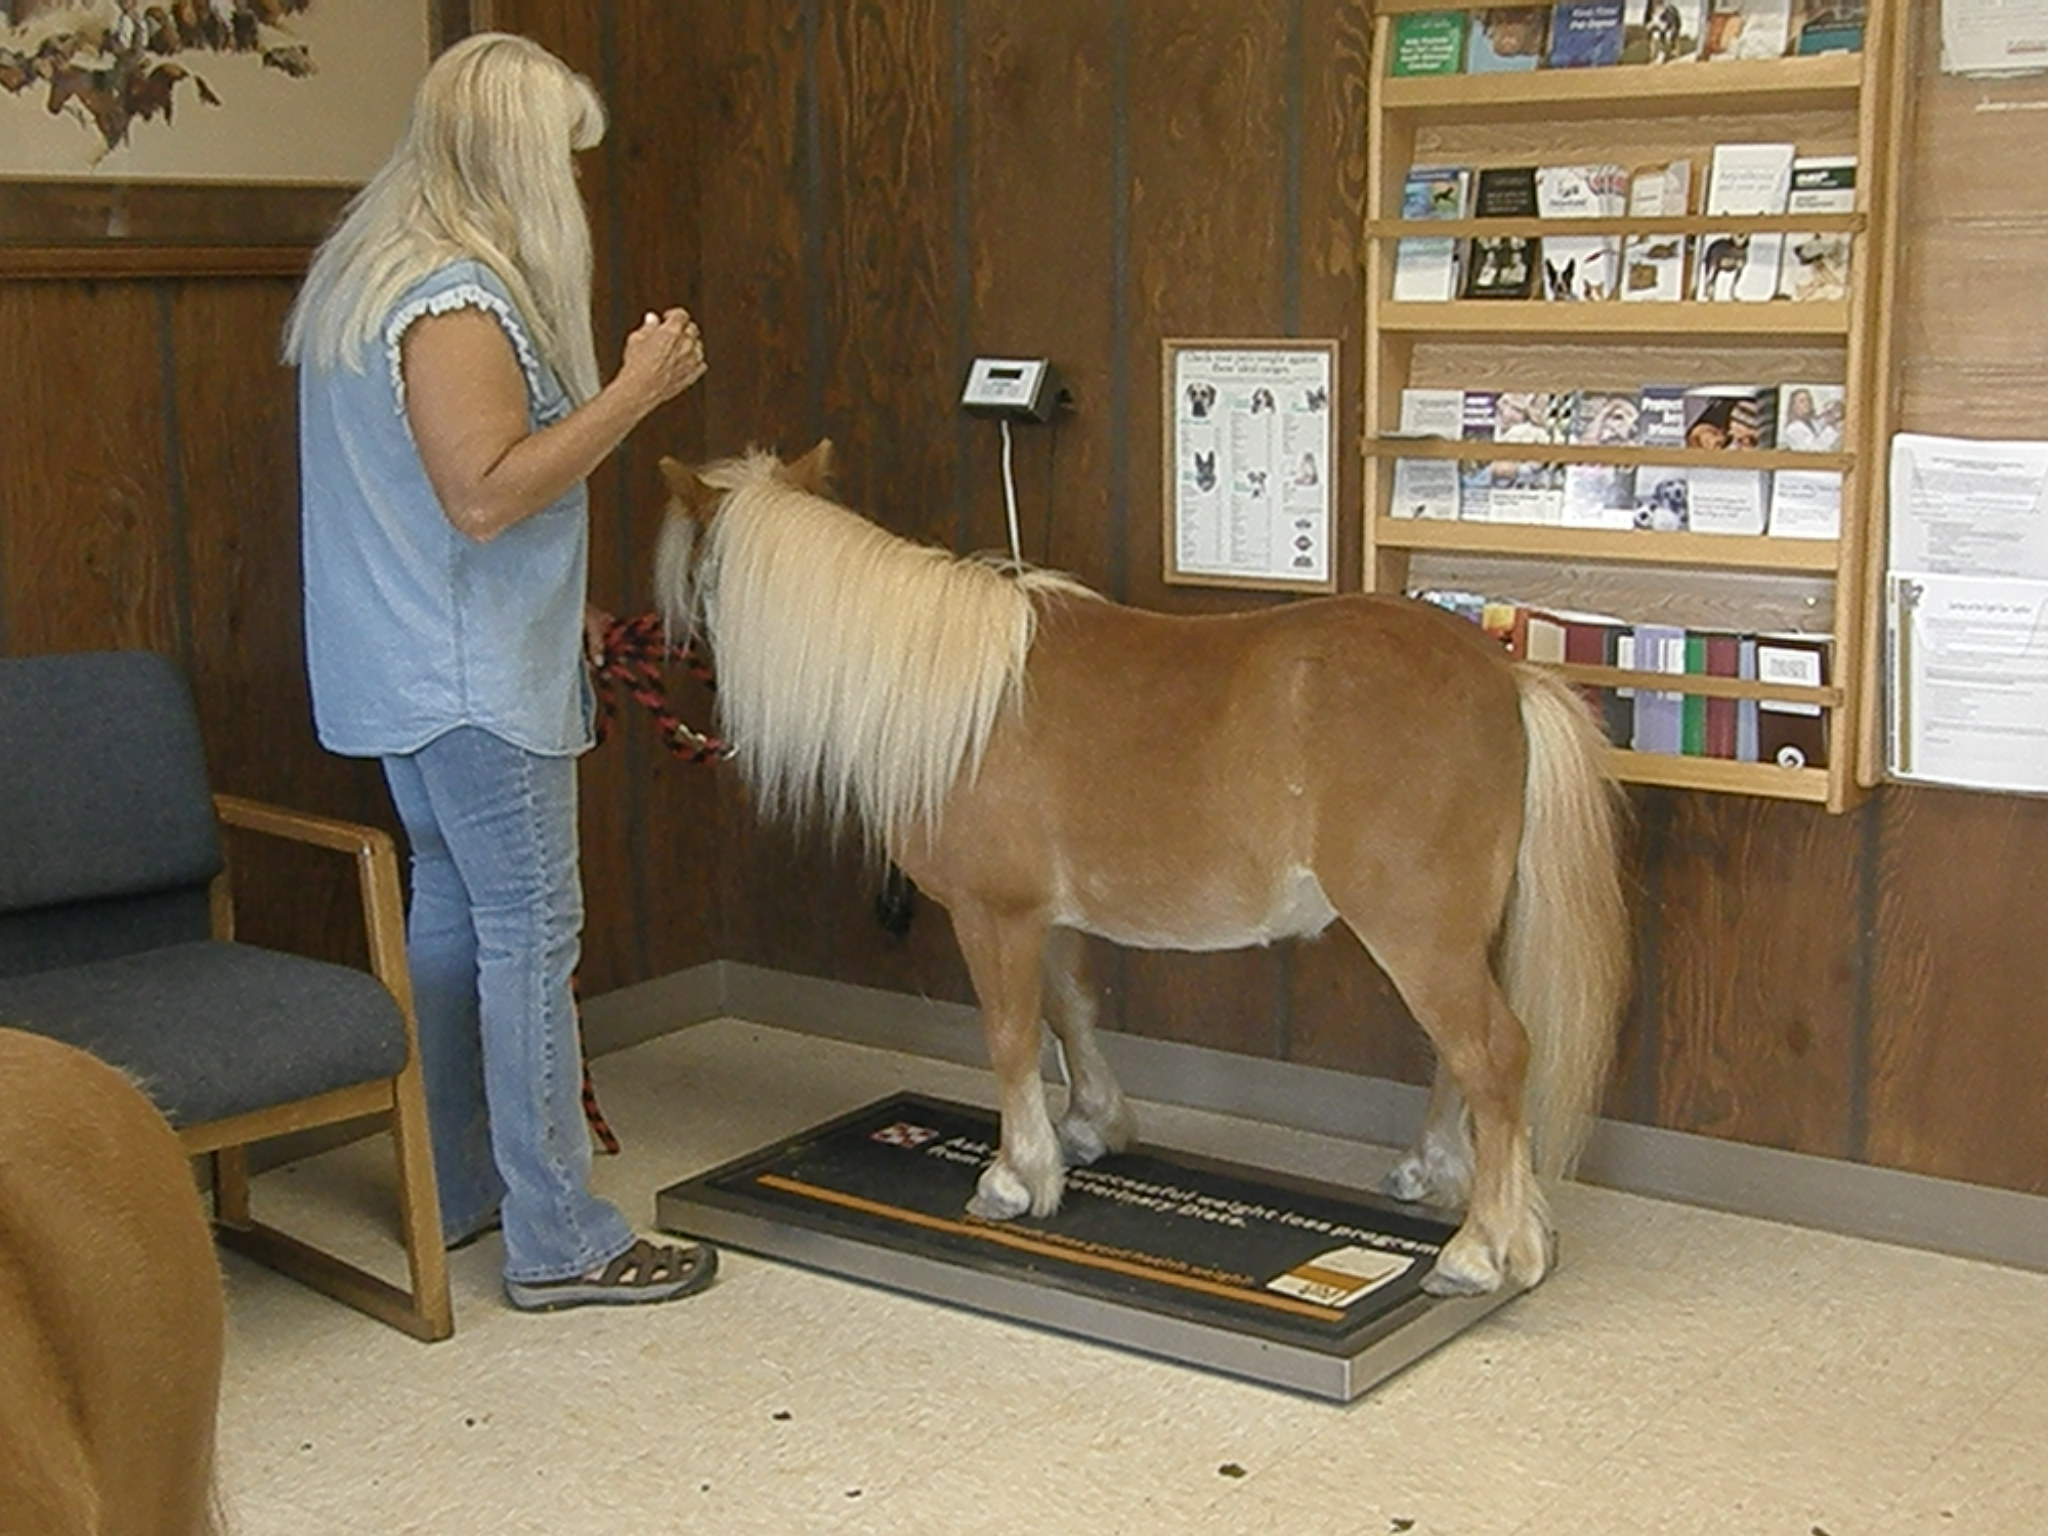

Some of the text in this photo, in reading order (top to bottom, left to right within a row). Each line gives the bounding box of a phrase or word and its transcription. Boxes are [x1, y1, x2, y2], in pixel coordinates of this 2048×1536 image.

[926, 1145, 982, 1166] from
[1071, 1167, 1199, 1202] successful
[1280, 1211, 1333, 1233] loss
